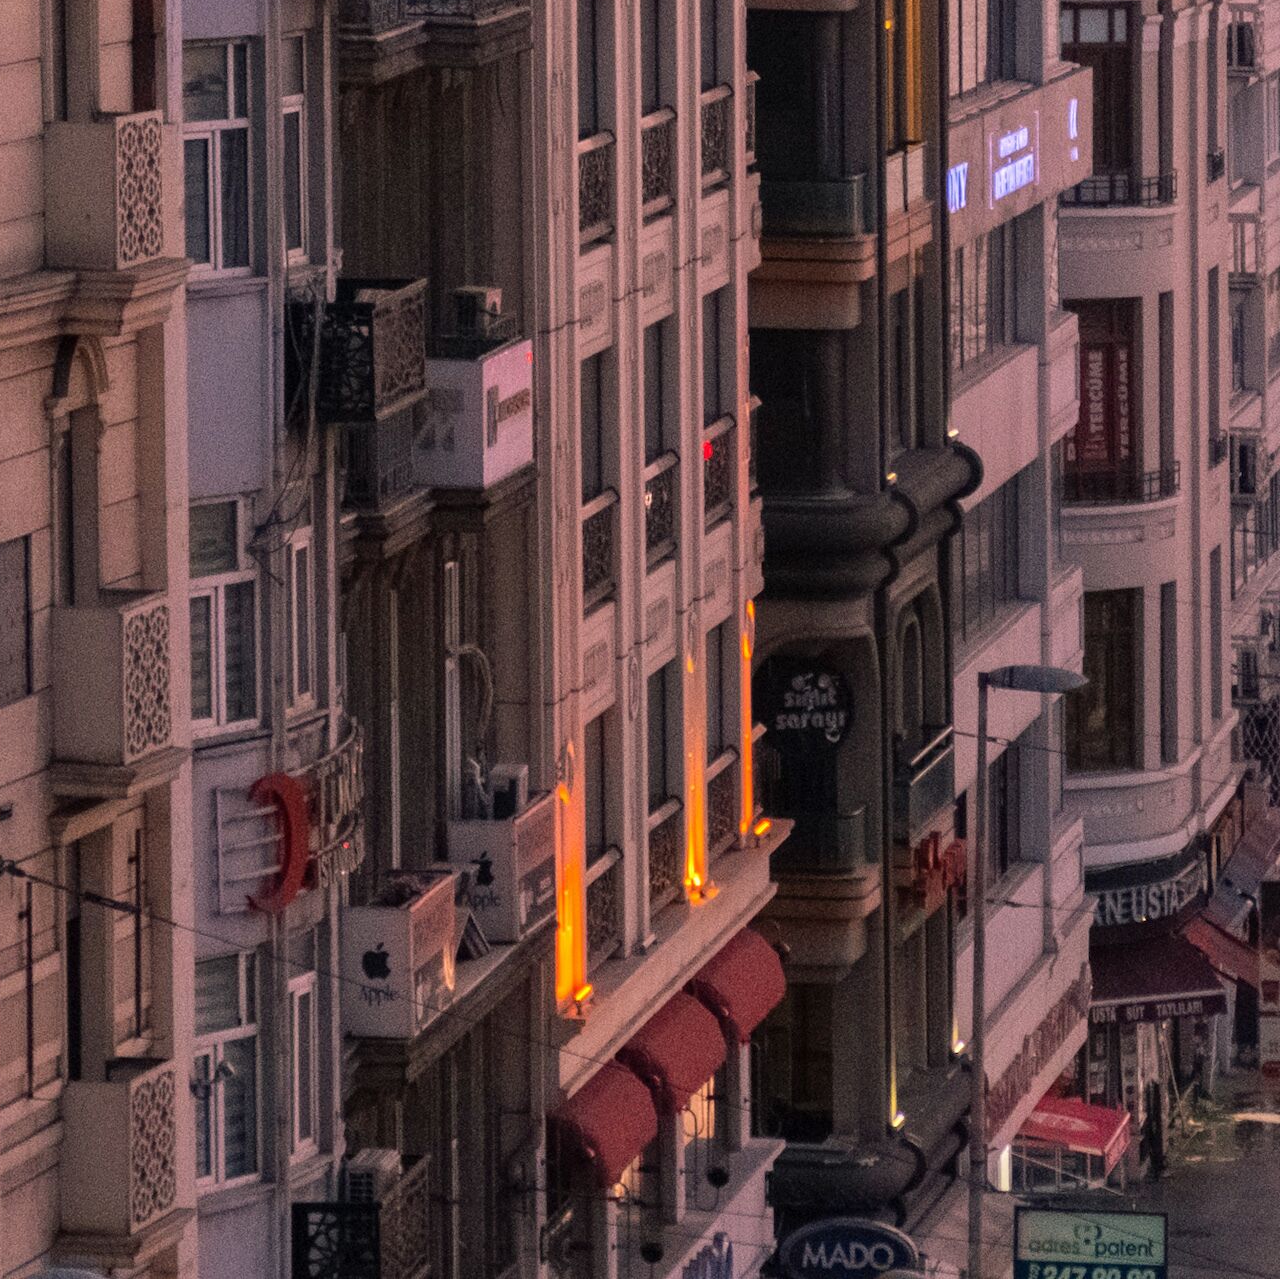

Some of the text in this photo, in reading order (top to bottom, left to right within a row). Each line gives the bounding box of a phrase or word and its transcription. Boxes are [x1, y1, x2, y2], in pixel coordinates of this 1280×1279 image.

[1086, 350, 1105, 433] TERÇÜME
[802, 1241, 895, 1270] MADO
[1094, 1238, 1154, 1258] patent
